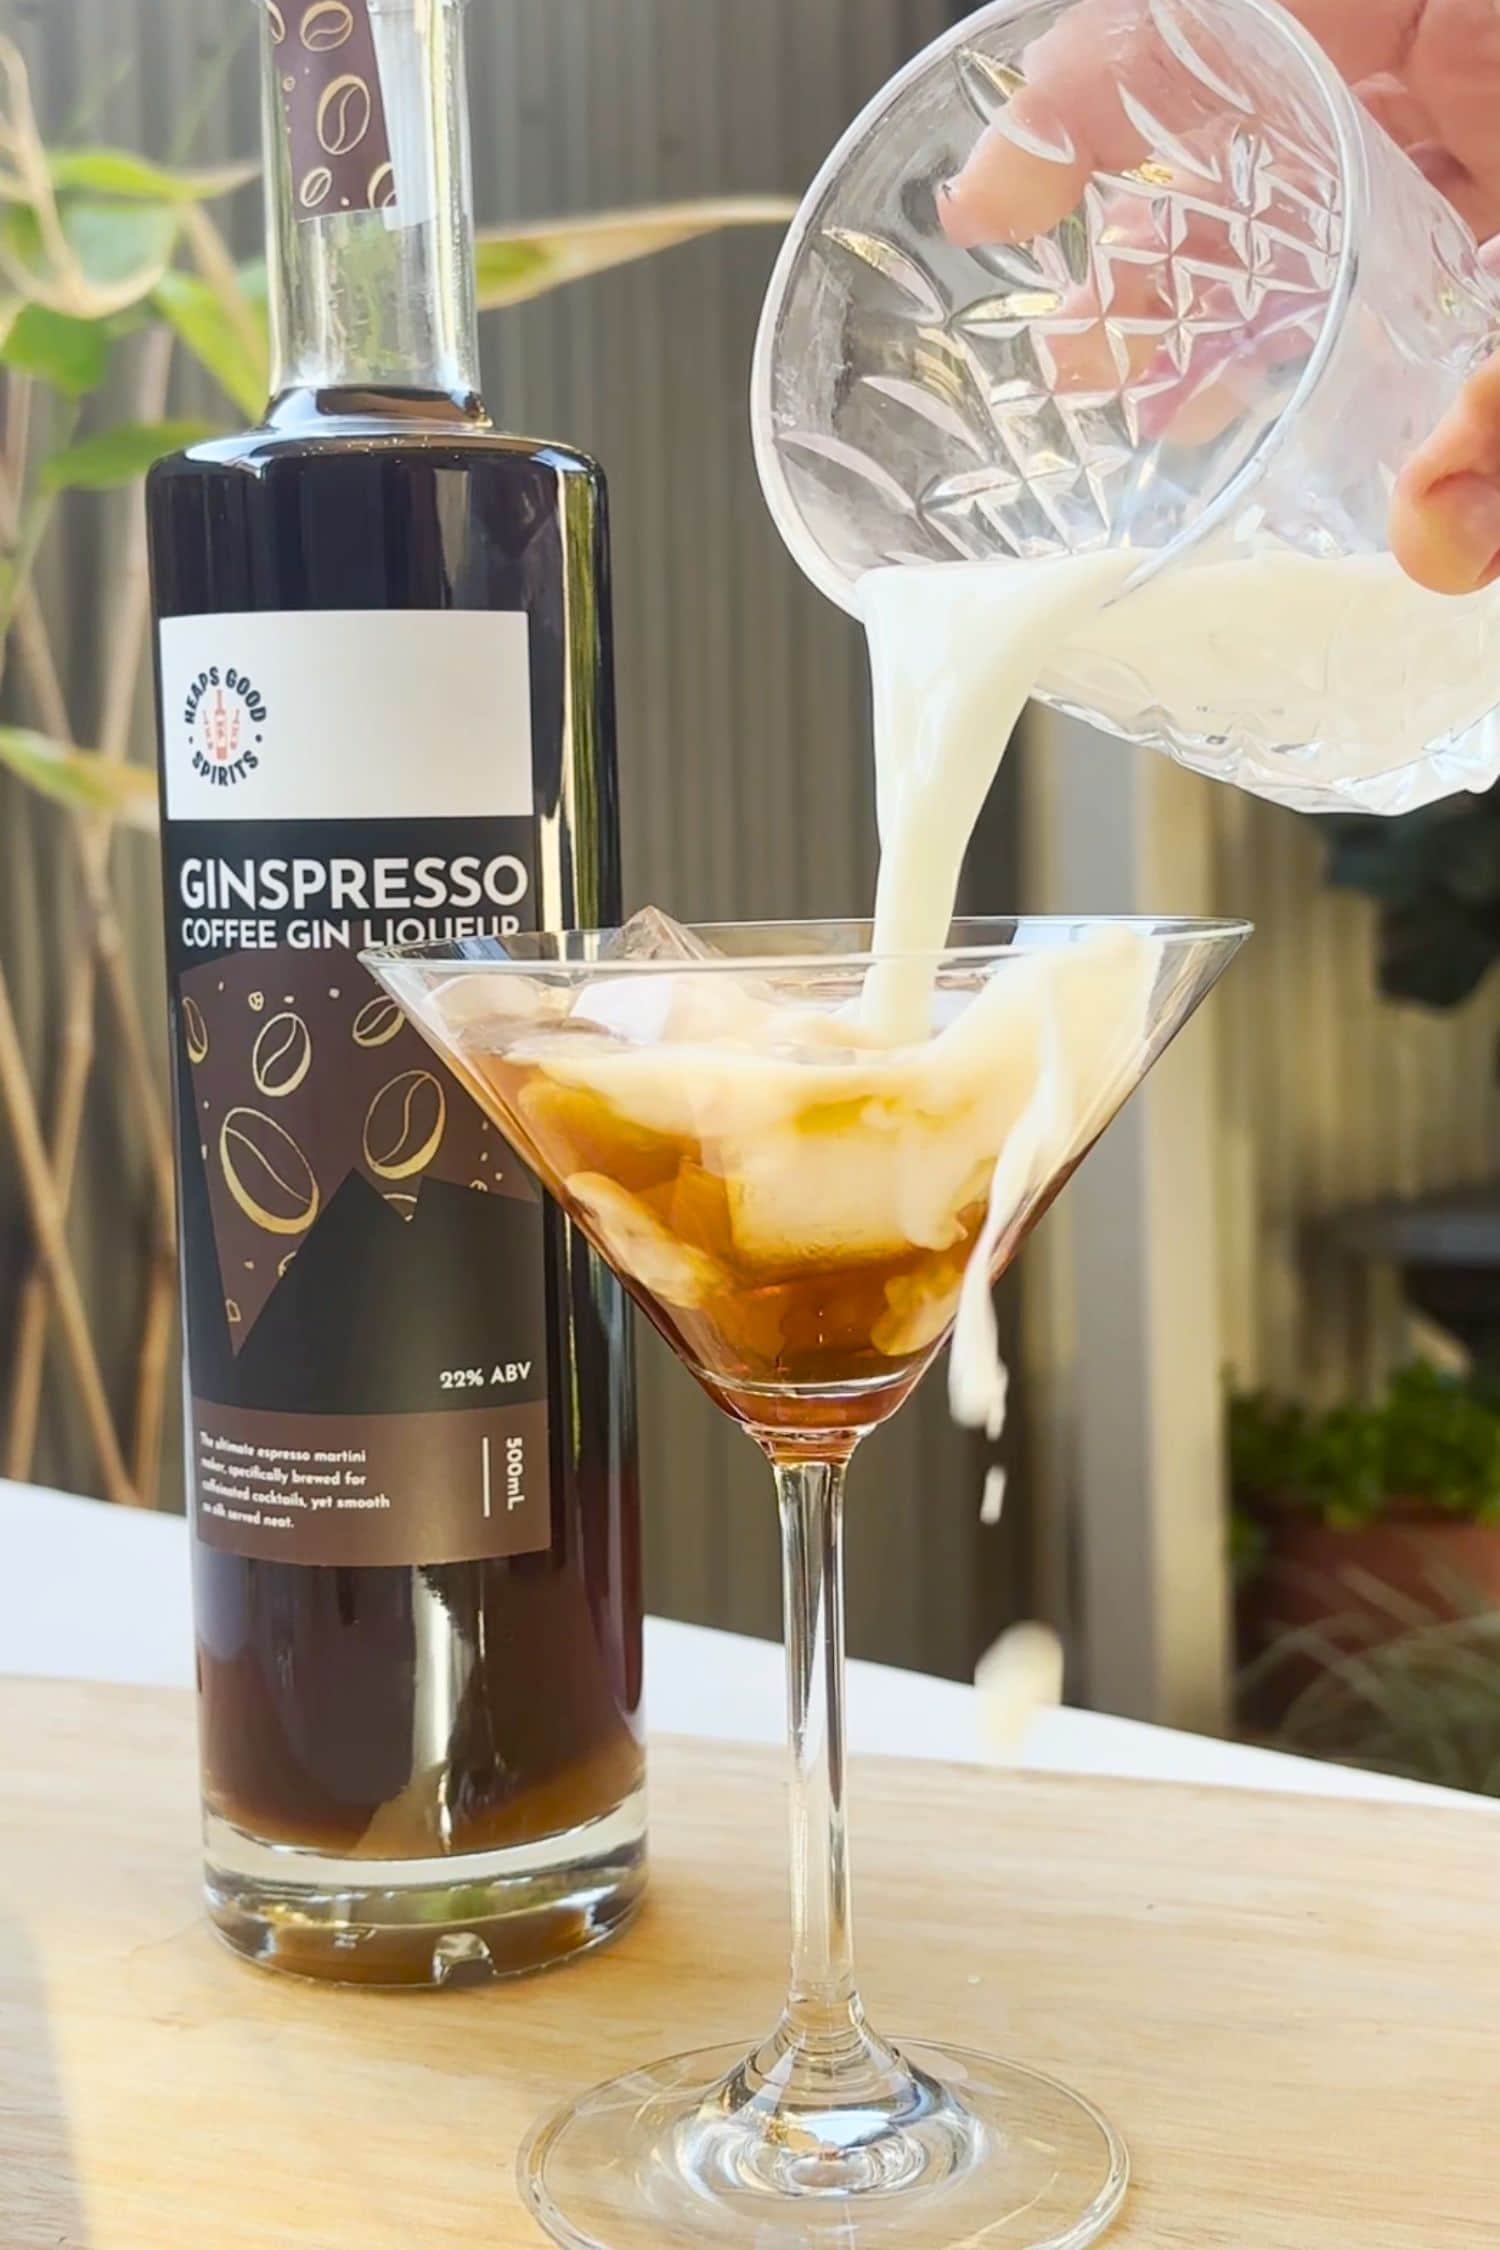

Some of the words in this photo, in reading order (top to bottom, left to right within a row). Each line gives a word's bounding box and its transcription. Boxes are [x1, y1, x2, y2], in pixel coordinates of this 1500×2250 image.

[184, 666, 220, 725] HEAPS
[225, 668, 267, 722] GOOD
[192, 750, 259, 787] SPIRITS
[180, 855, 529, 911] GINSPRESSO
[182, 917, 278, 949] COFFEE
[286, 919, 350, 949] GIN
[440, 1368, 485, 1389] 22%
[490, 1361, 531, 1385] ABV
[257, 1447, 310, 1462] espresso
[314, 1449, 366, 1463] martini
[228, 1464, 289, 1485] specifically
[292, 1469, 341, 1486] brewed
[345, 1471, 367, 1486] for
[506, 1437, 525, 1511] 500mL
[252, 1489, 308, 1508] cocktails,
[311, 1496, 333, 1511] yet
[337, 1494, 391, 1509] smooth
[227, 1509, 261, 1525] served
[263, 1515, 295, 1529] neat.
